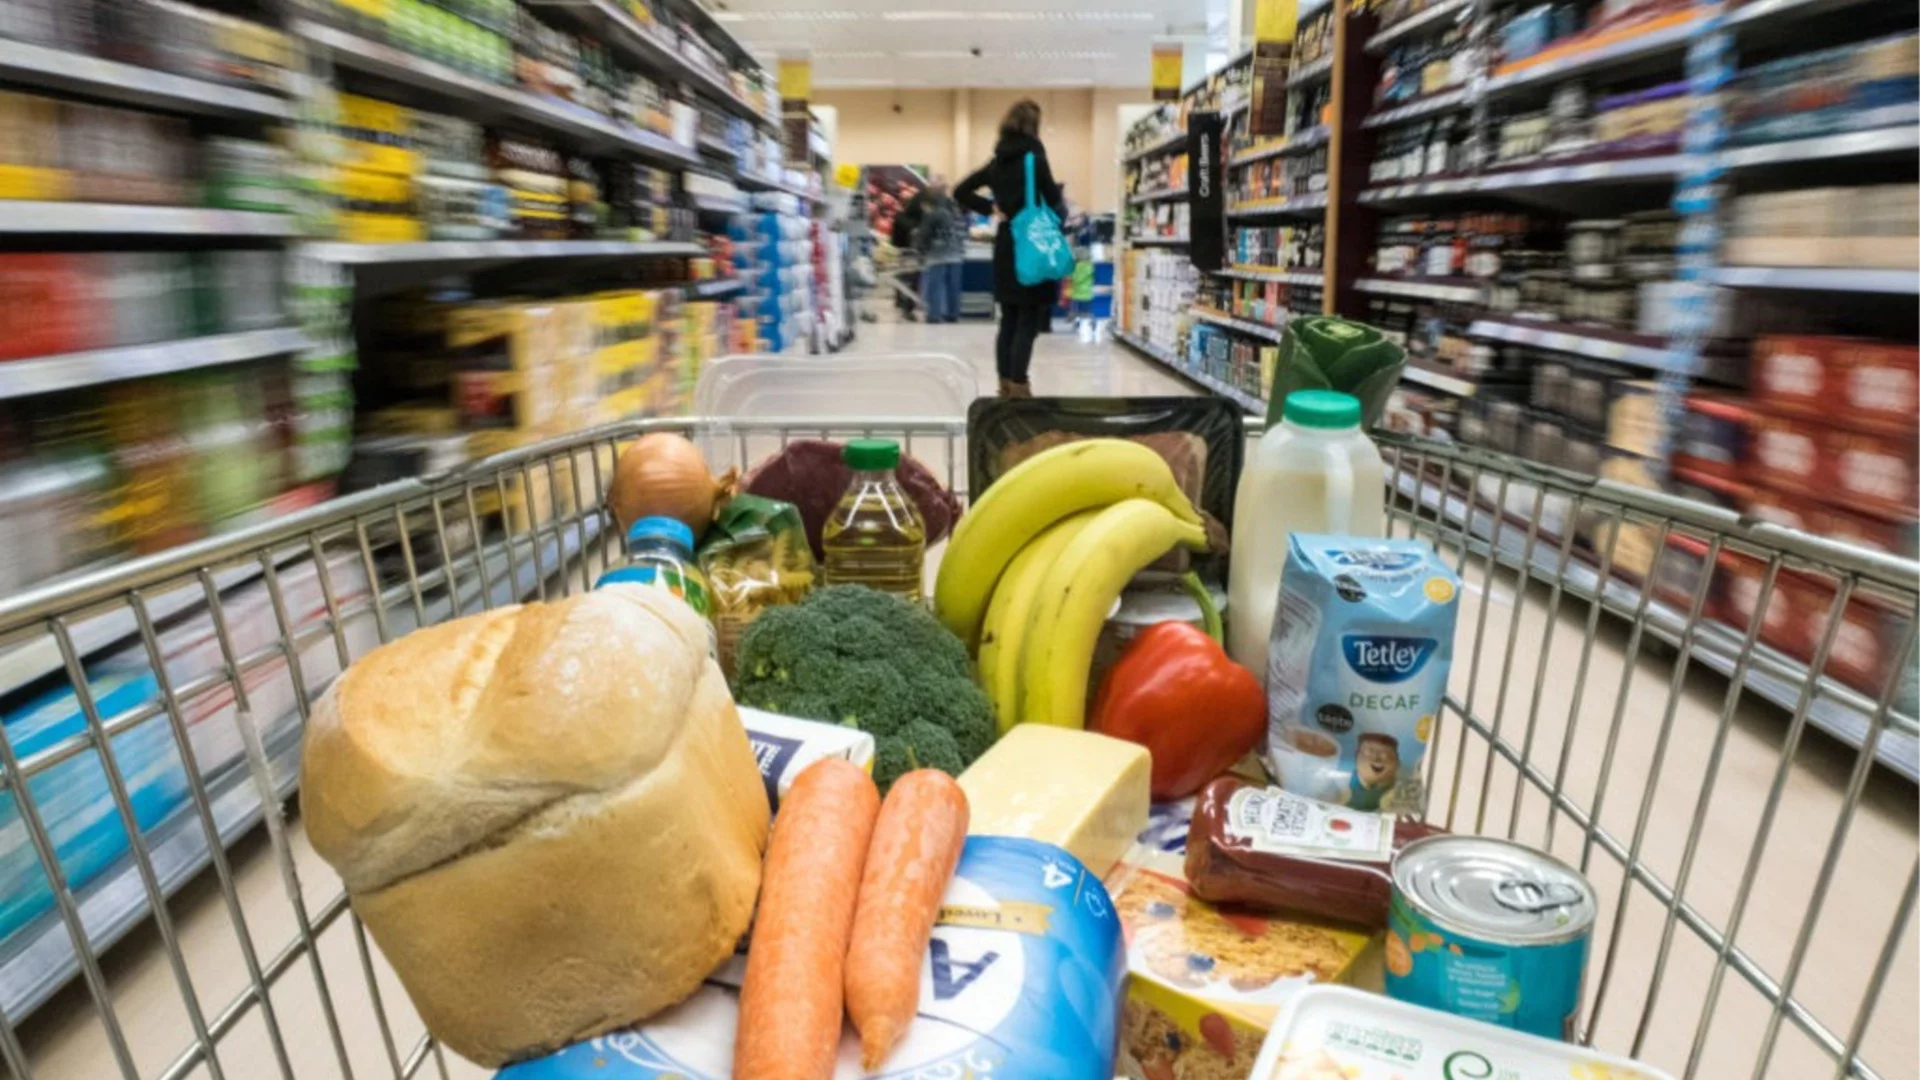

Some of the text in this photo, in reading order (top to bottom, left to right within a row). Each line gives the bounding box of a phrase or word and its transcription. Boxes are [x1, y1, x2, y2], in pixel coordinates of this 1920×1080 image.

[1354, 641, 1424, 672] Tetley
[1350, 692, 1421, 710] DECAF
[1244, 795, 1267, 825] HEINZ
[1041, 862, 1073, 889] 4
